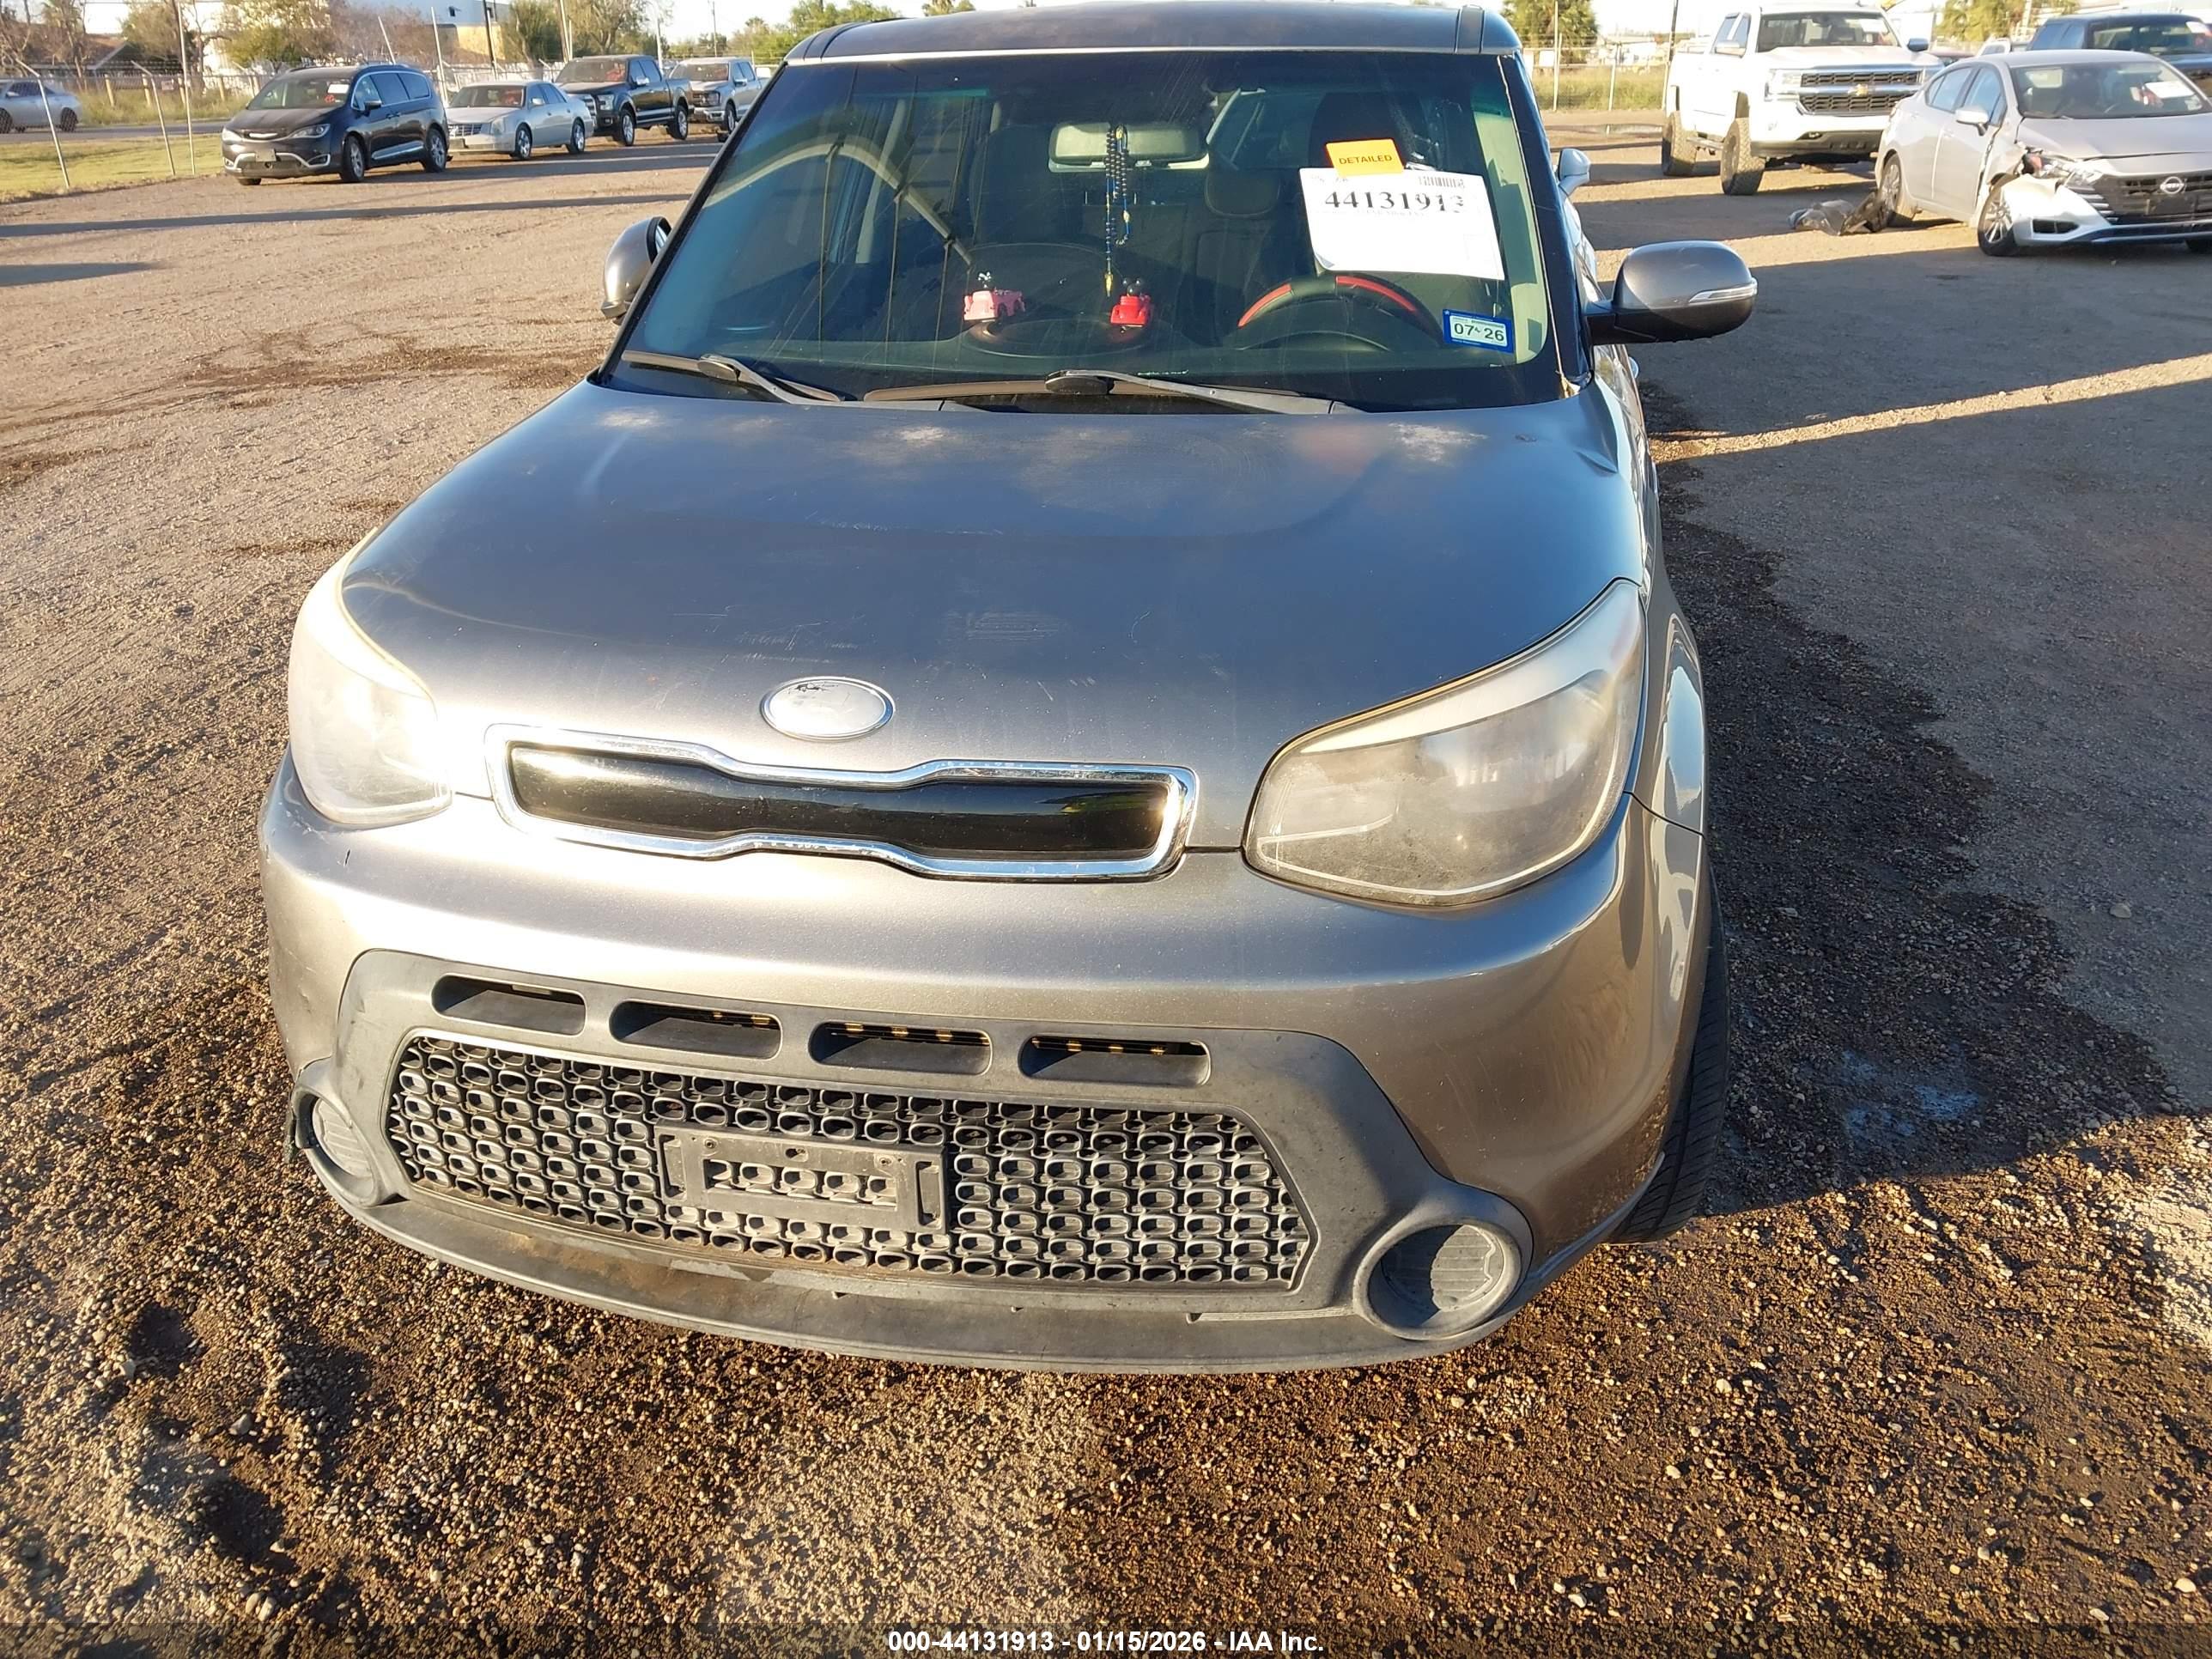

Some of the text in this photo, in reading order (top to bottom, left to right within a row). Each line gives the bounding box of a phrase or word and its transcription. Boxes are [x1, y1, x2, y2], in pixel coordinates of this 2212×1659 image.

[1338, 155, 1393, 166] DETAILED
[1454, 323, 1475, 336] 07
[1483, 327, 1504, 342] 26
